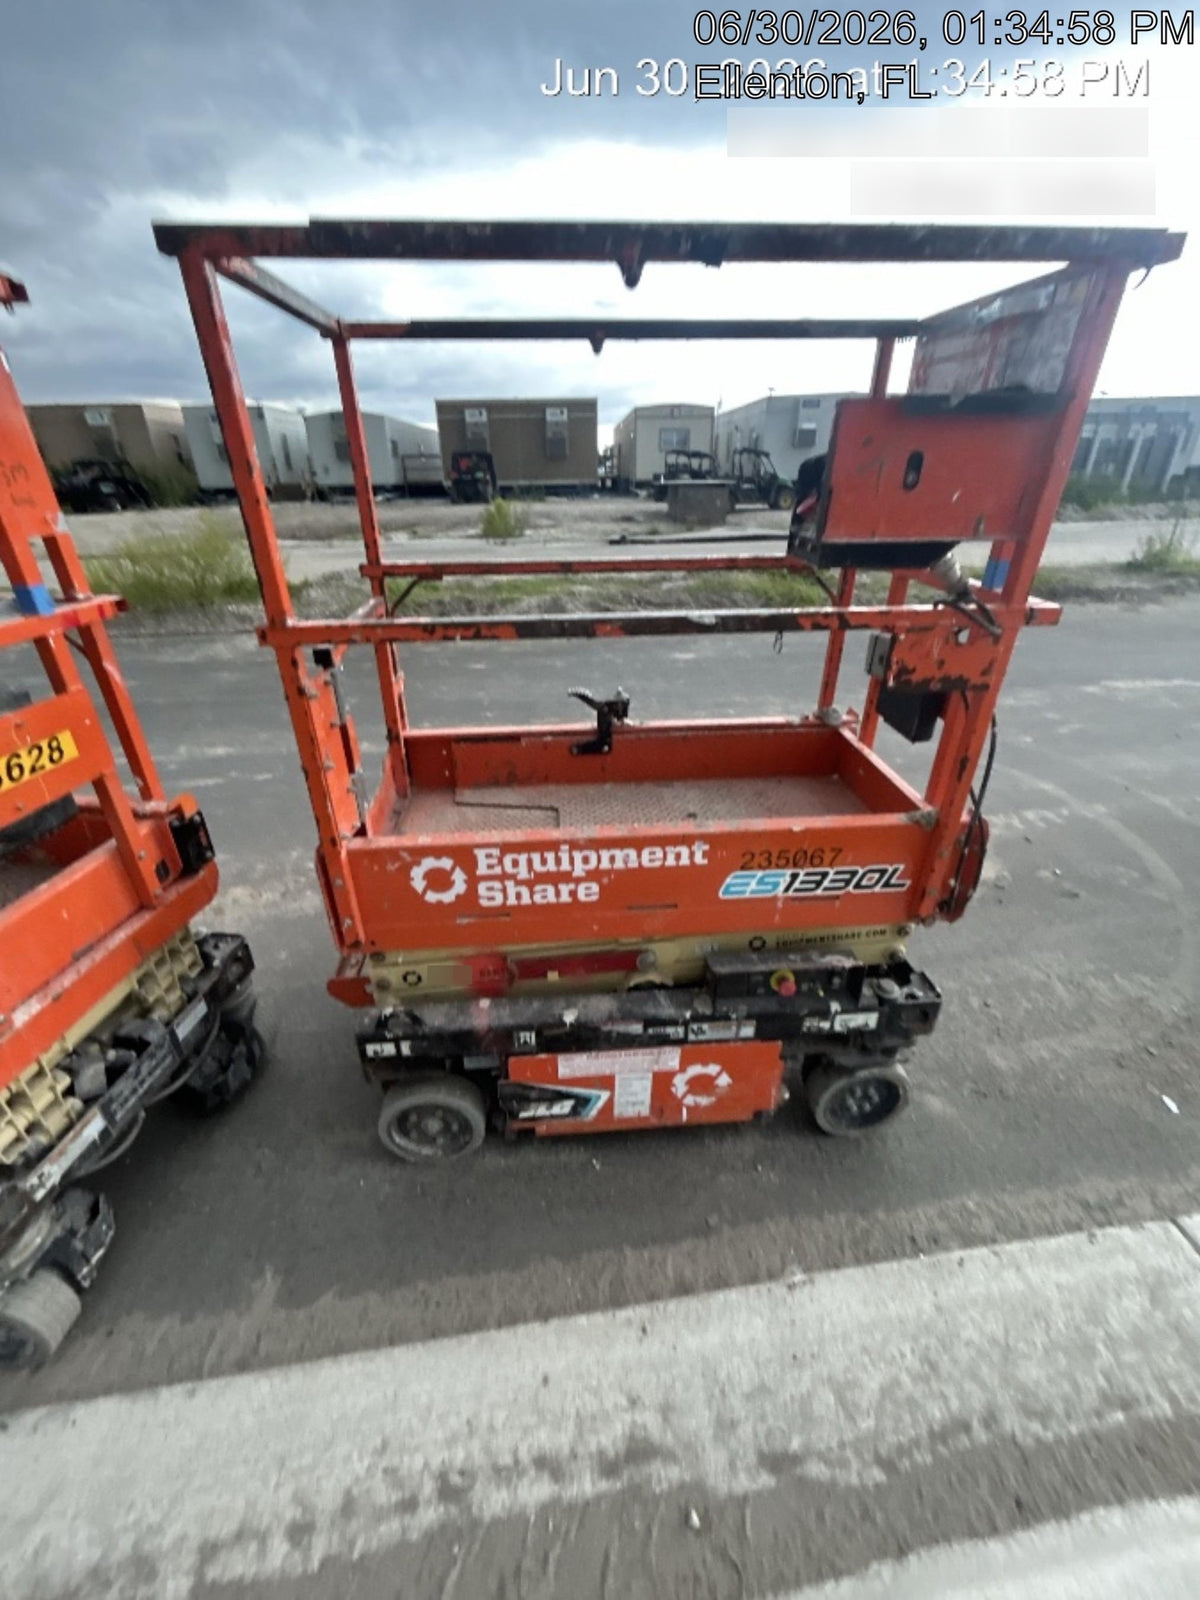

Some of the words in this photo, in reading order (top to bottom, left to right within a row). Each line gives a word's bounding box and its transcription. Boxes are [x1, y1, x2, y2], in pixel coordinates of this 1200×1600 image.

[0, 735, 64, 790] 628
[473, 840, 710, 880] Equipment
[740, 848, 843, 870] 235067
[477, 877, 600, 907] Share
[719, 865, 910, 898] ES1330L
